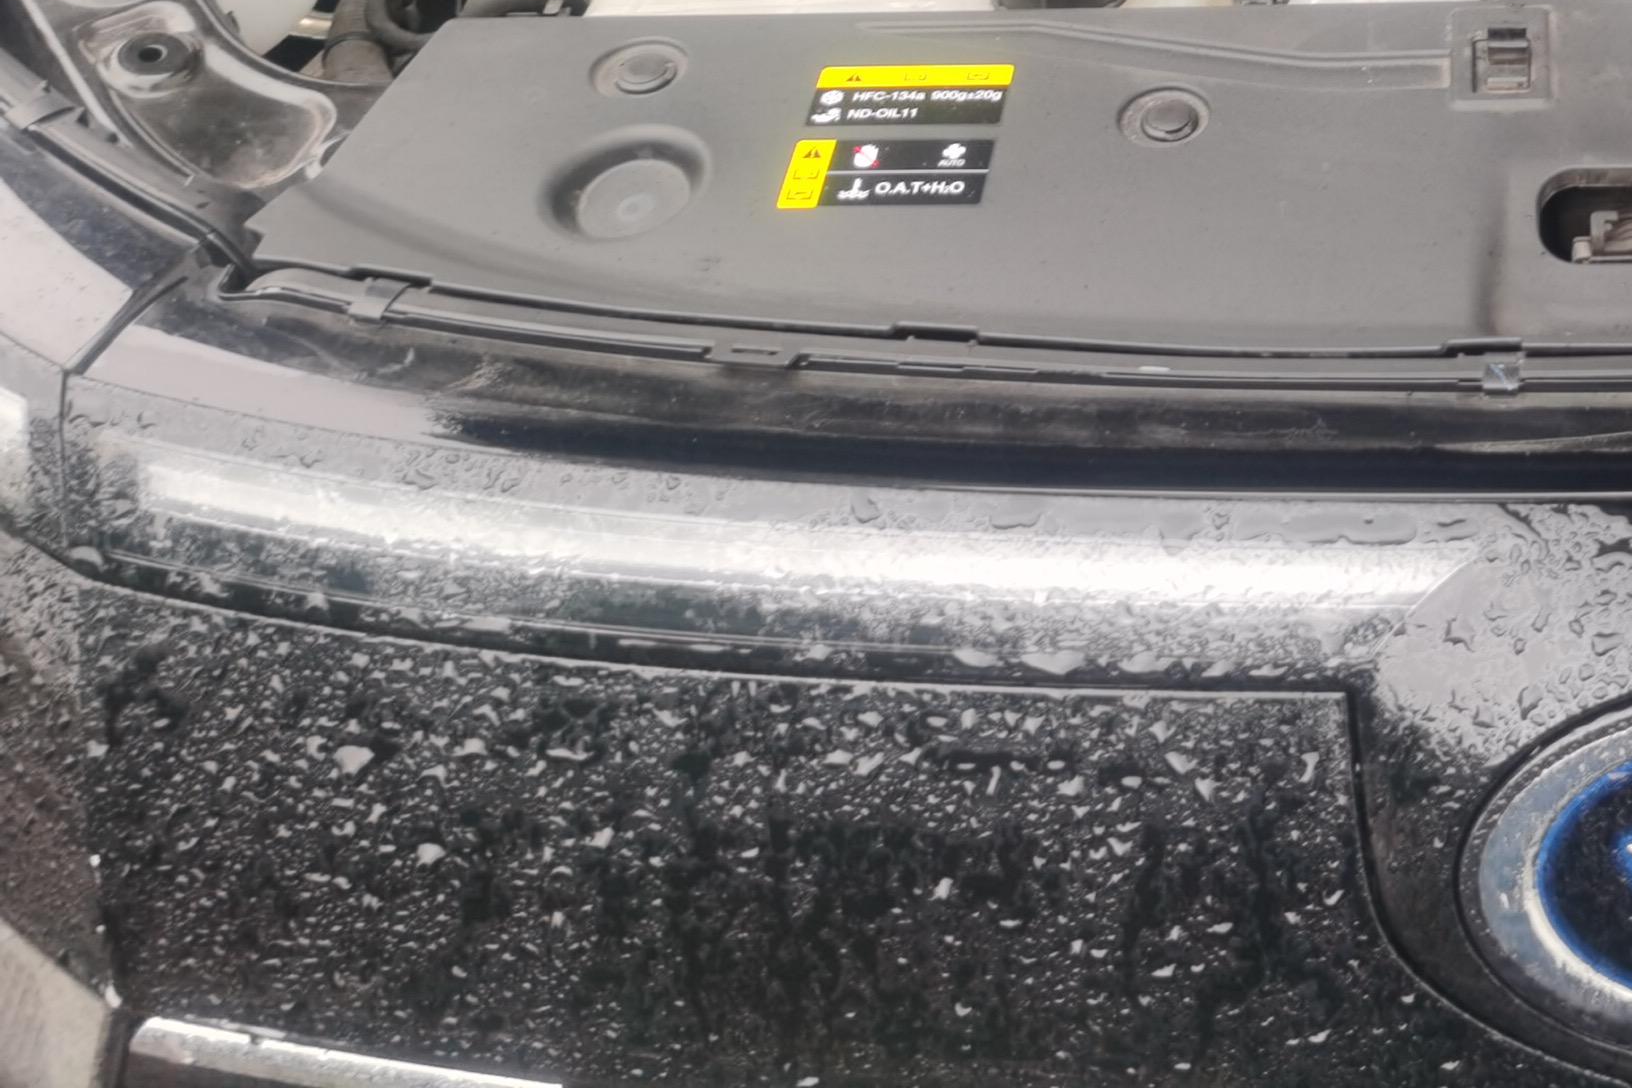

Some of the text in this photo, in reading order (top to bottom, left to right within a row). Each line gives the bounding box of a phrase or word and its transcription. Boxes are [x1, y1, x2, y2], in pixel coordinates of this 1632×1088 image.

[852, 91, 926, 101] HFC-134a
[847, 108, 918, 119] ND-OIL11
[937, 159, 966, 167] AUTO
